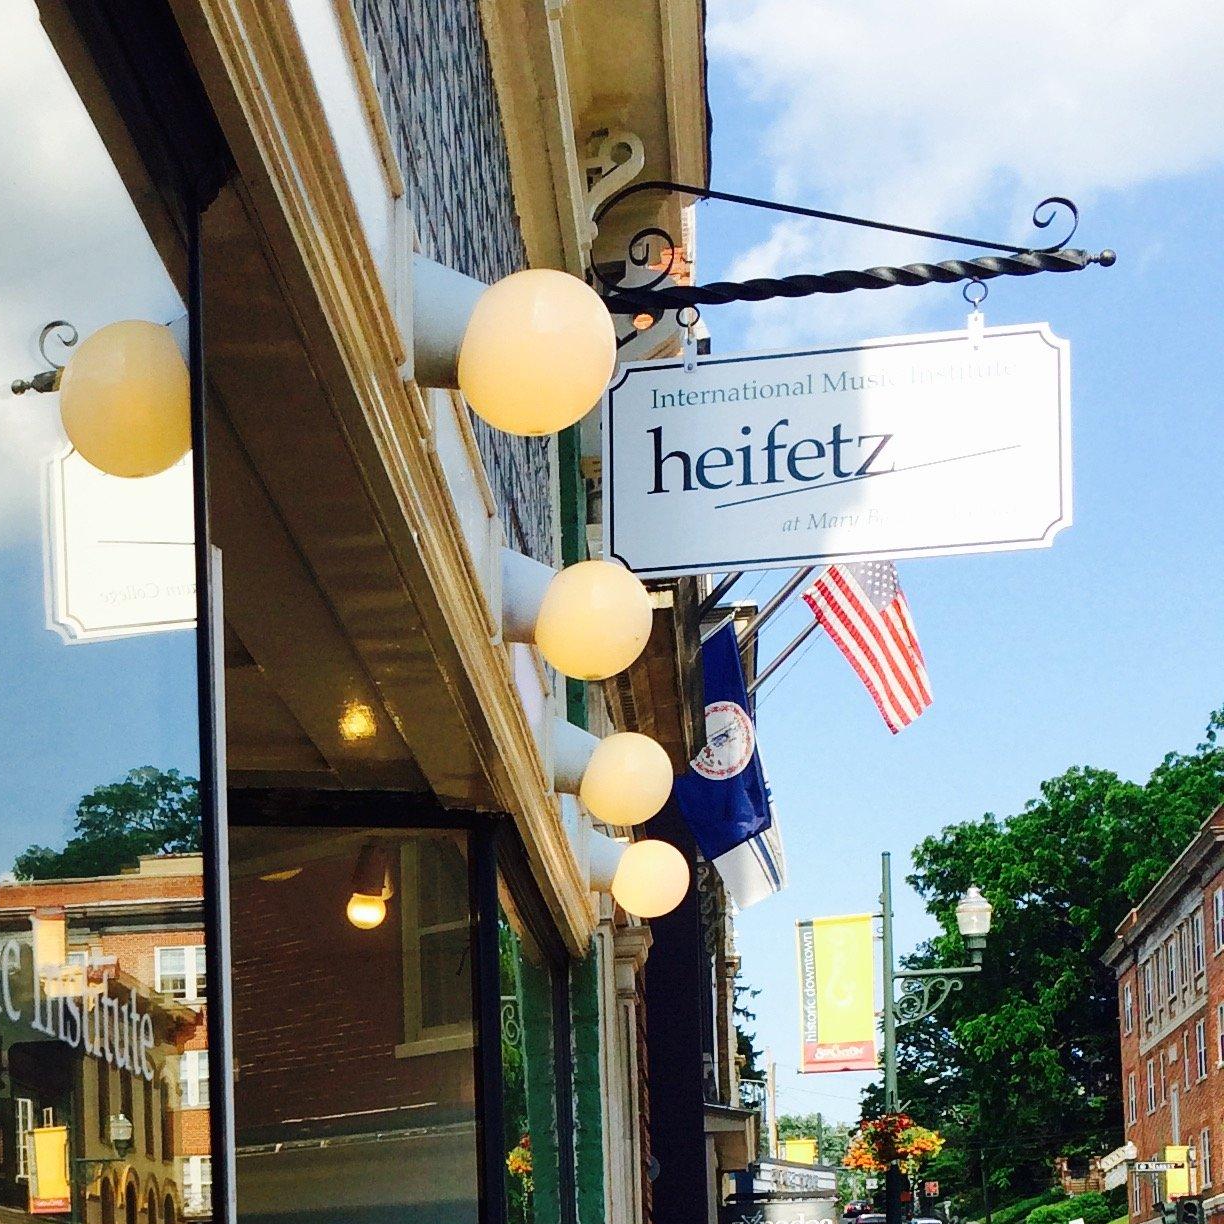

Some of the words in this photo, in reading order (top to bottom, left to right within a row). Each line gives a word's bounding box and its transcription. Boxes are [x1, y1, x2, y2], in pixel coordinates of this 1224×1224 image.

[651, 378, 815, 410] International
[821, 369, 898, 396] Music
[646, 418, 896, 496] heifetz
[781, 514, 801, 534] at
[806, 511, 859, 534] Mary
[802, 931, 817, 997] downtown
[30, 914, 157, 1082] Institute
[805, 1000, 818, 1043] historic
